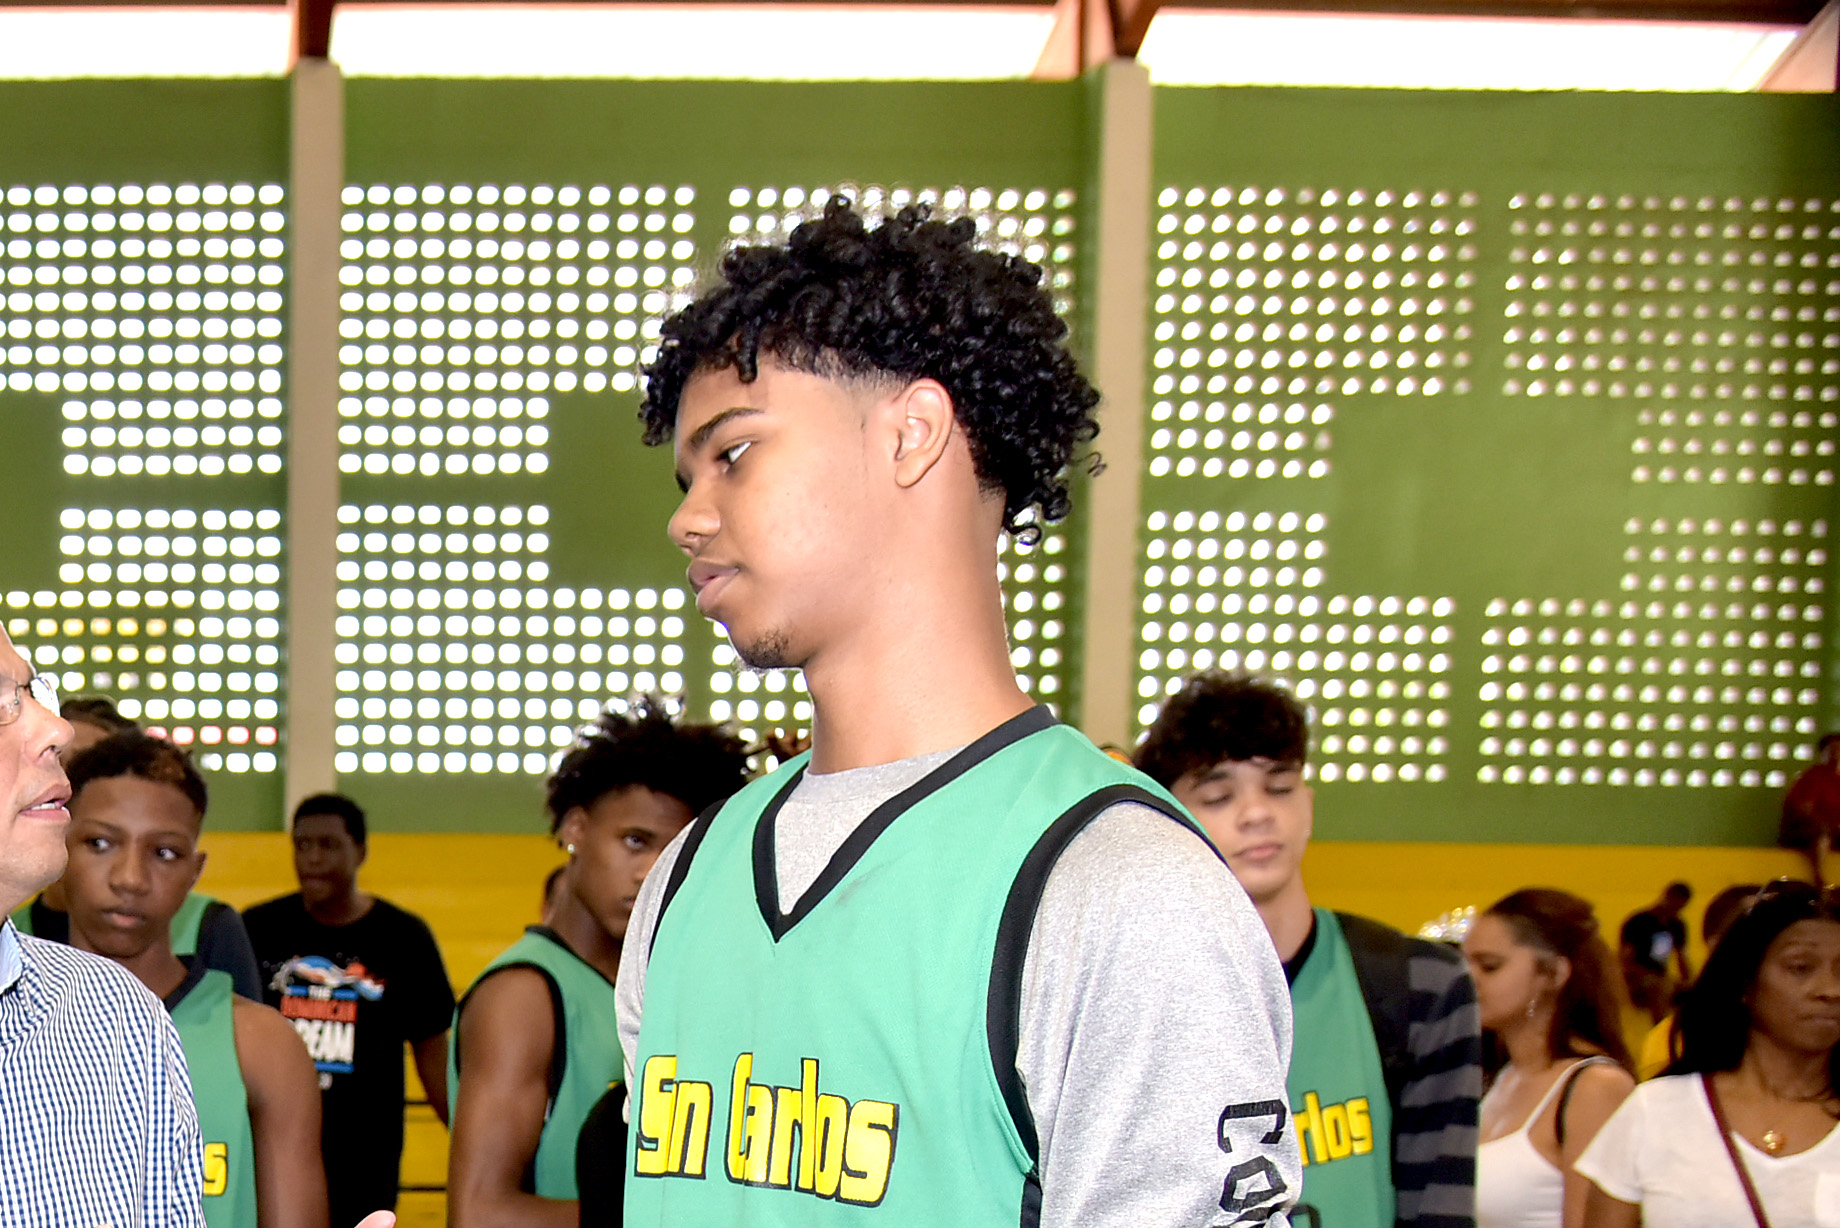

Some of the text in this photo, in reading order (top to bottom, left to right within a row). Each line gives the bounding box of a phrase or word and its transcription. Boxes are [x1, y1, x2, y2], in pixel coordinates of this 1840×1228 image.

[634, 1052, 901, 1209] Sn Carlos
[1291, 1089, 1375, 1168] rlos
